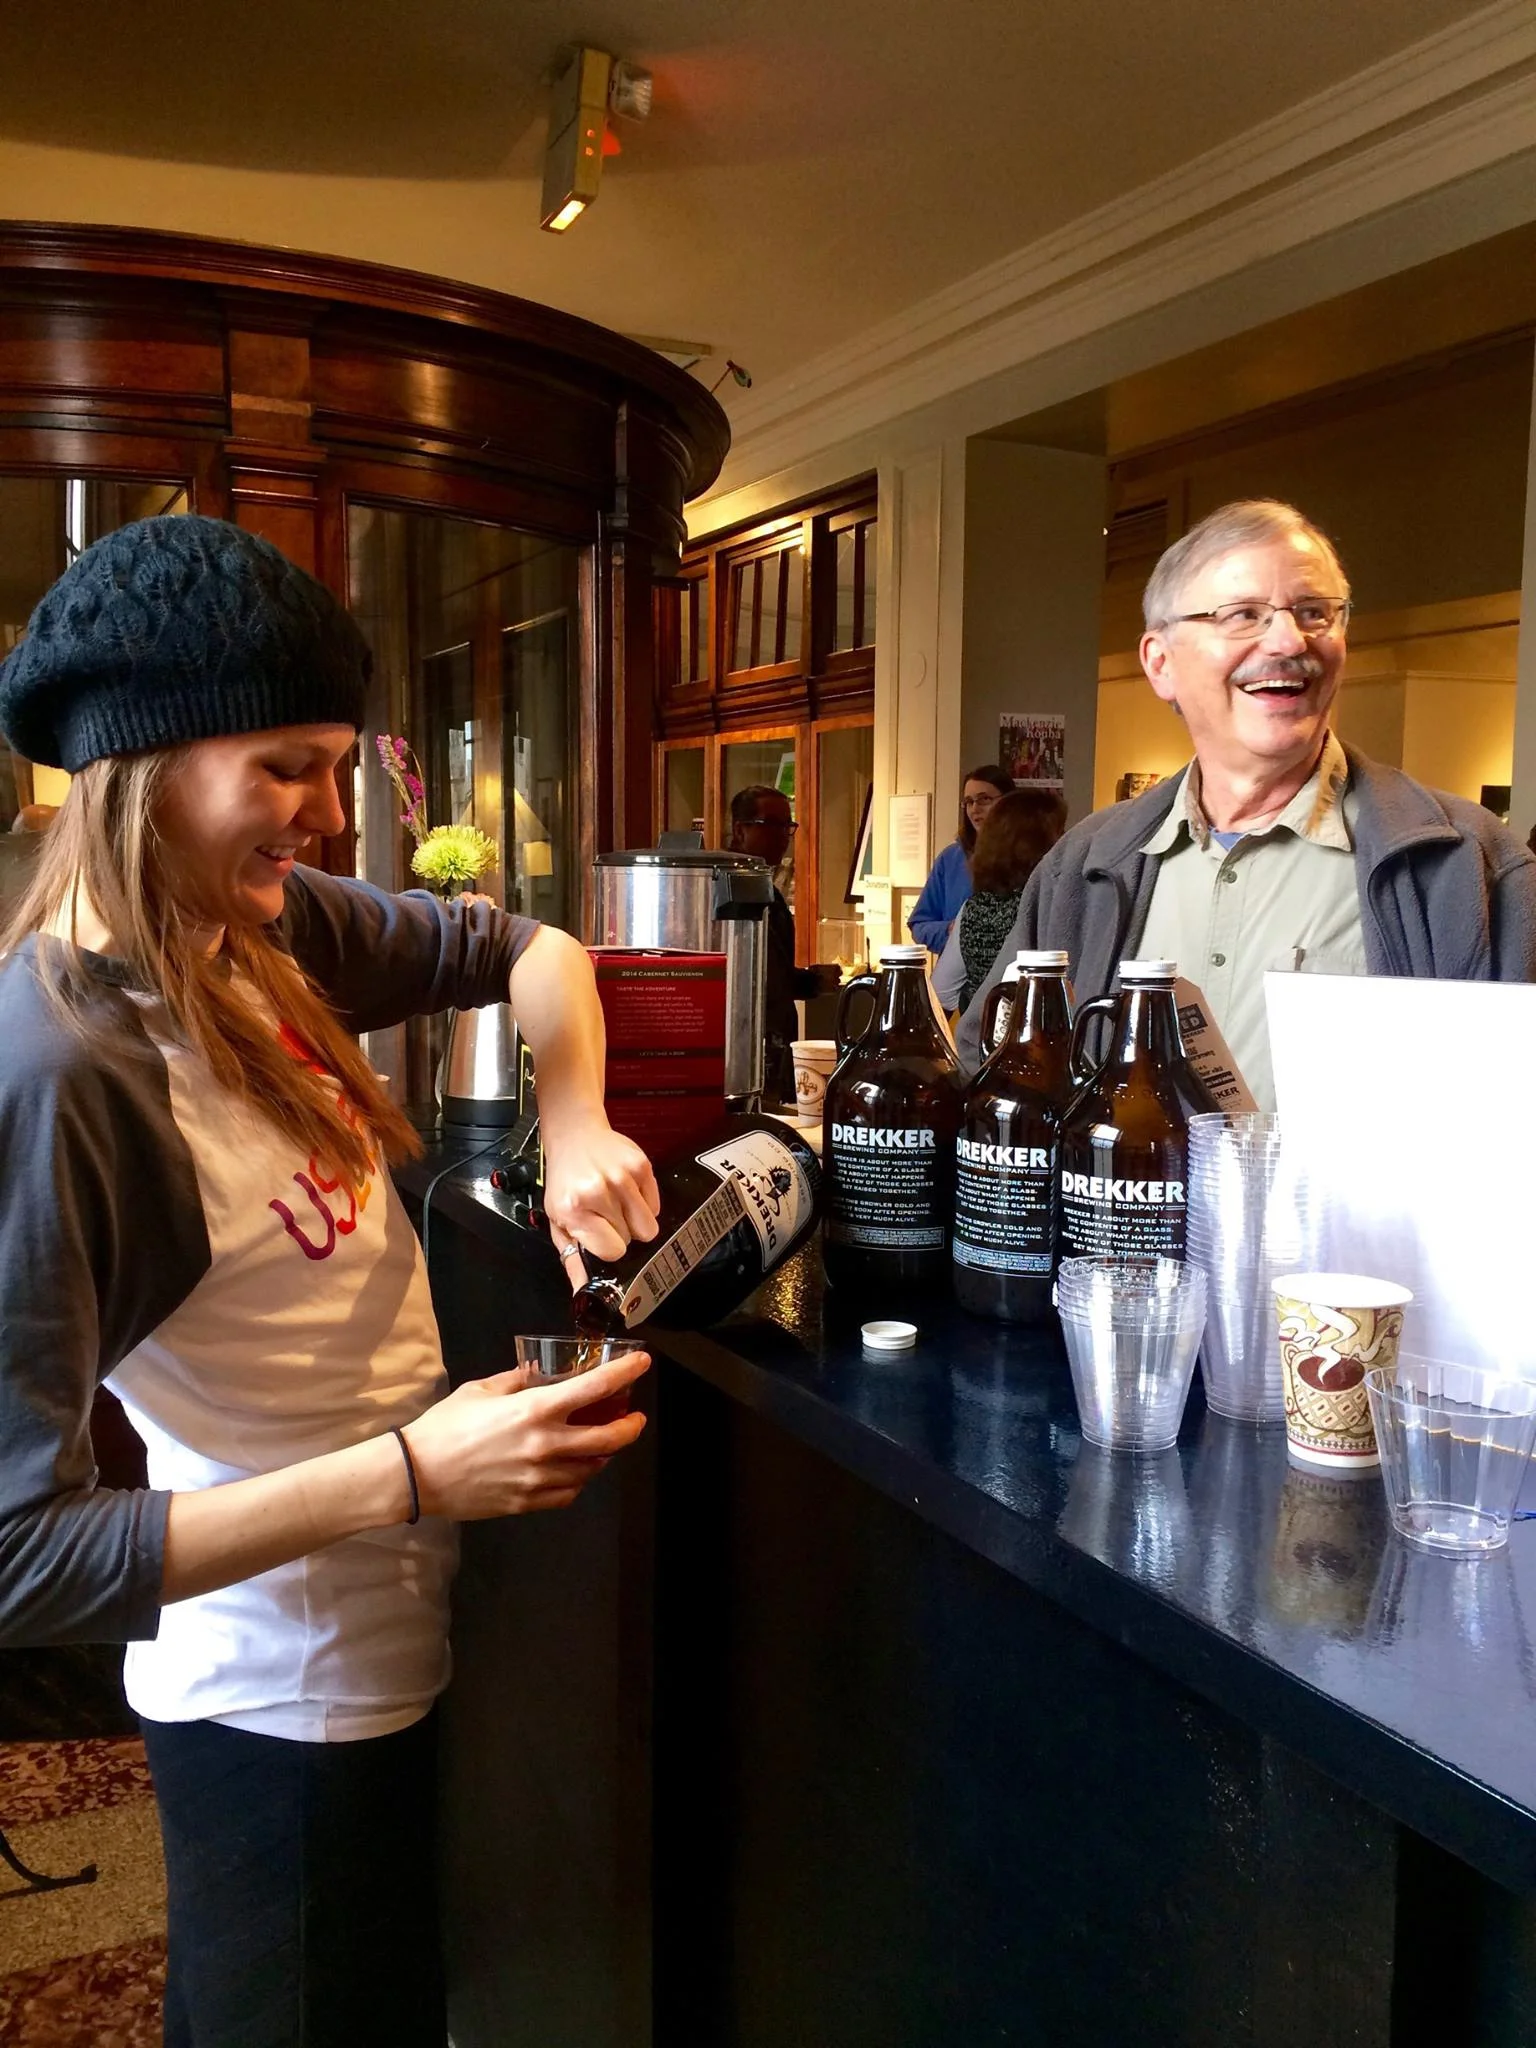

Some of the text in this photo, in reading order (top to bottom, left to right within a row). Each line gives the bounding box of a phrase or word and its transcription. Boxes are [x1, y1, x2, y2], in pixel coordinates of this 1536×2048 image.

[832, 1123, 936, 1148] DREKKER
[843, 1145, 875, 1154] BREWING
[956, 1136, 1048, 1168] DREKKER
[867, 1158, 889, 1166] ABOUT
[848, 1164, 880, 1172] CONTENTS
[988, 1165, 1030, 1174] COMPANY
[848, 1170, 869, 1178] ABOUT
[979, 1176, 1000, 1184] ABOUT
[1062, 1170, 1186, 1203] DREKKER
[1000, 1194, 1036, 1202] HAPPENS
[720, 1159, 777, 1250] DREKKER
[860, 1200, 892, 1208] GROWLER
[986, 1200, 1010, 1208] THOSE
[1073, 1196, 1166, 1212] BREWING COMPANY
[1067, 1216, 1078, 1224] THE
[1080, 1220, 1118, 1231] CONTENTS
[1102, 1214, 1130, 1224] ABOUT
[1080, 1228, 1104, 1237] ABOUT
[1106, 1232, 1129, 1240] WHAT
[983, 1236, 1002, 1244] MUCH
[1084, 1236, 1098, 1244] FEW
[1113, 1241, 1142, 1249] THOSE
[1086, 1245, 1114, 1254] RAISED
